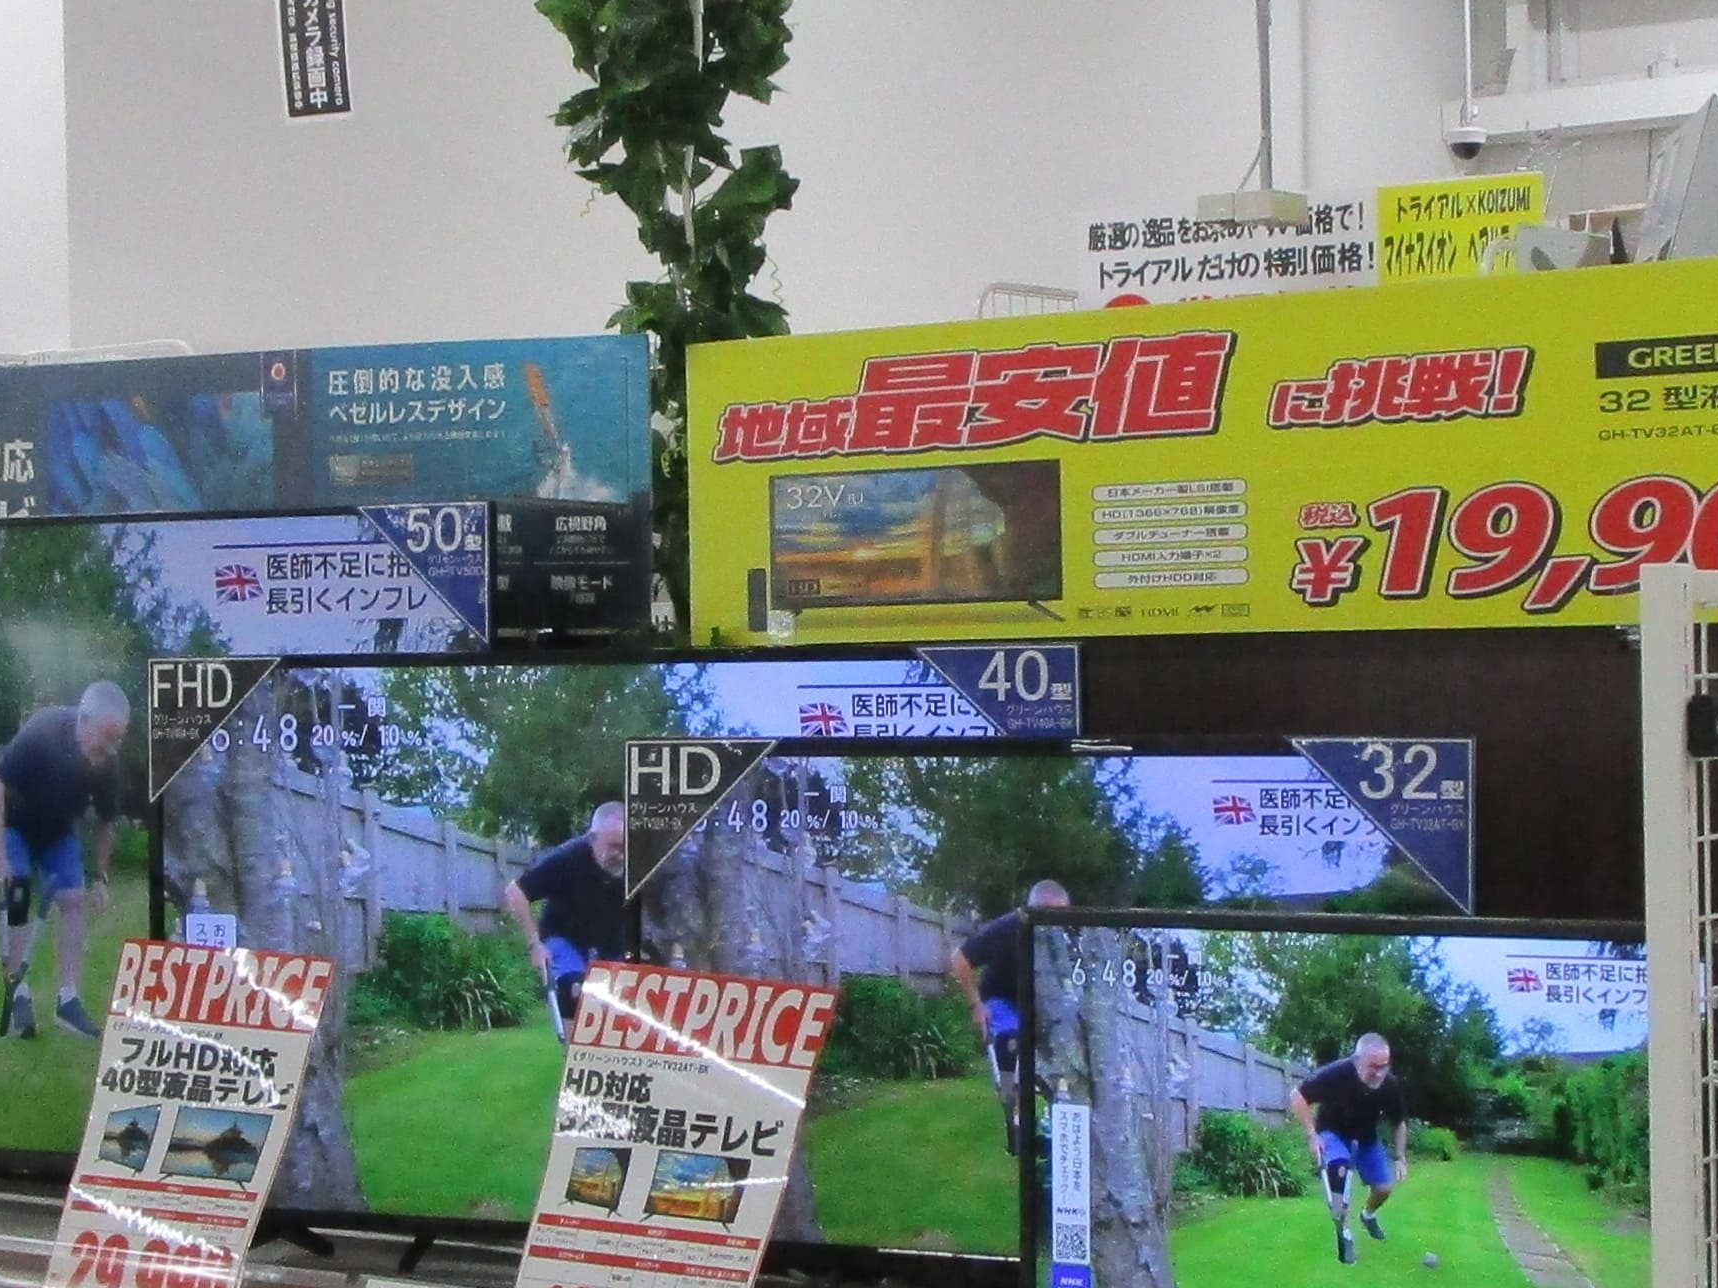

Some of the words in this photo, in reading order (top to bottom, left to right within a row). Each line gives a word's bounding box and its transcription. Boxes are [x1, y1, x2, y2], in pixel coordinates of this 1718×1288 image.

[328, 362, 506, 396] 圧倒的な没入感
[713, 331, 1238, 462] 地域最安値
[329, 398, 507, 426] ベゼルレスデザイン
[267, 587, 427, 615] 長引くインフレ
[152, 663, 233, 709] FHD
[630, 746, 721, 796] HD
[1072, 958, 1136, 988] 6:48
[565, 1068, 654, 1104] HD対応
